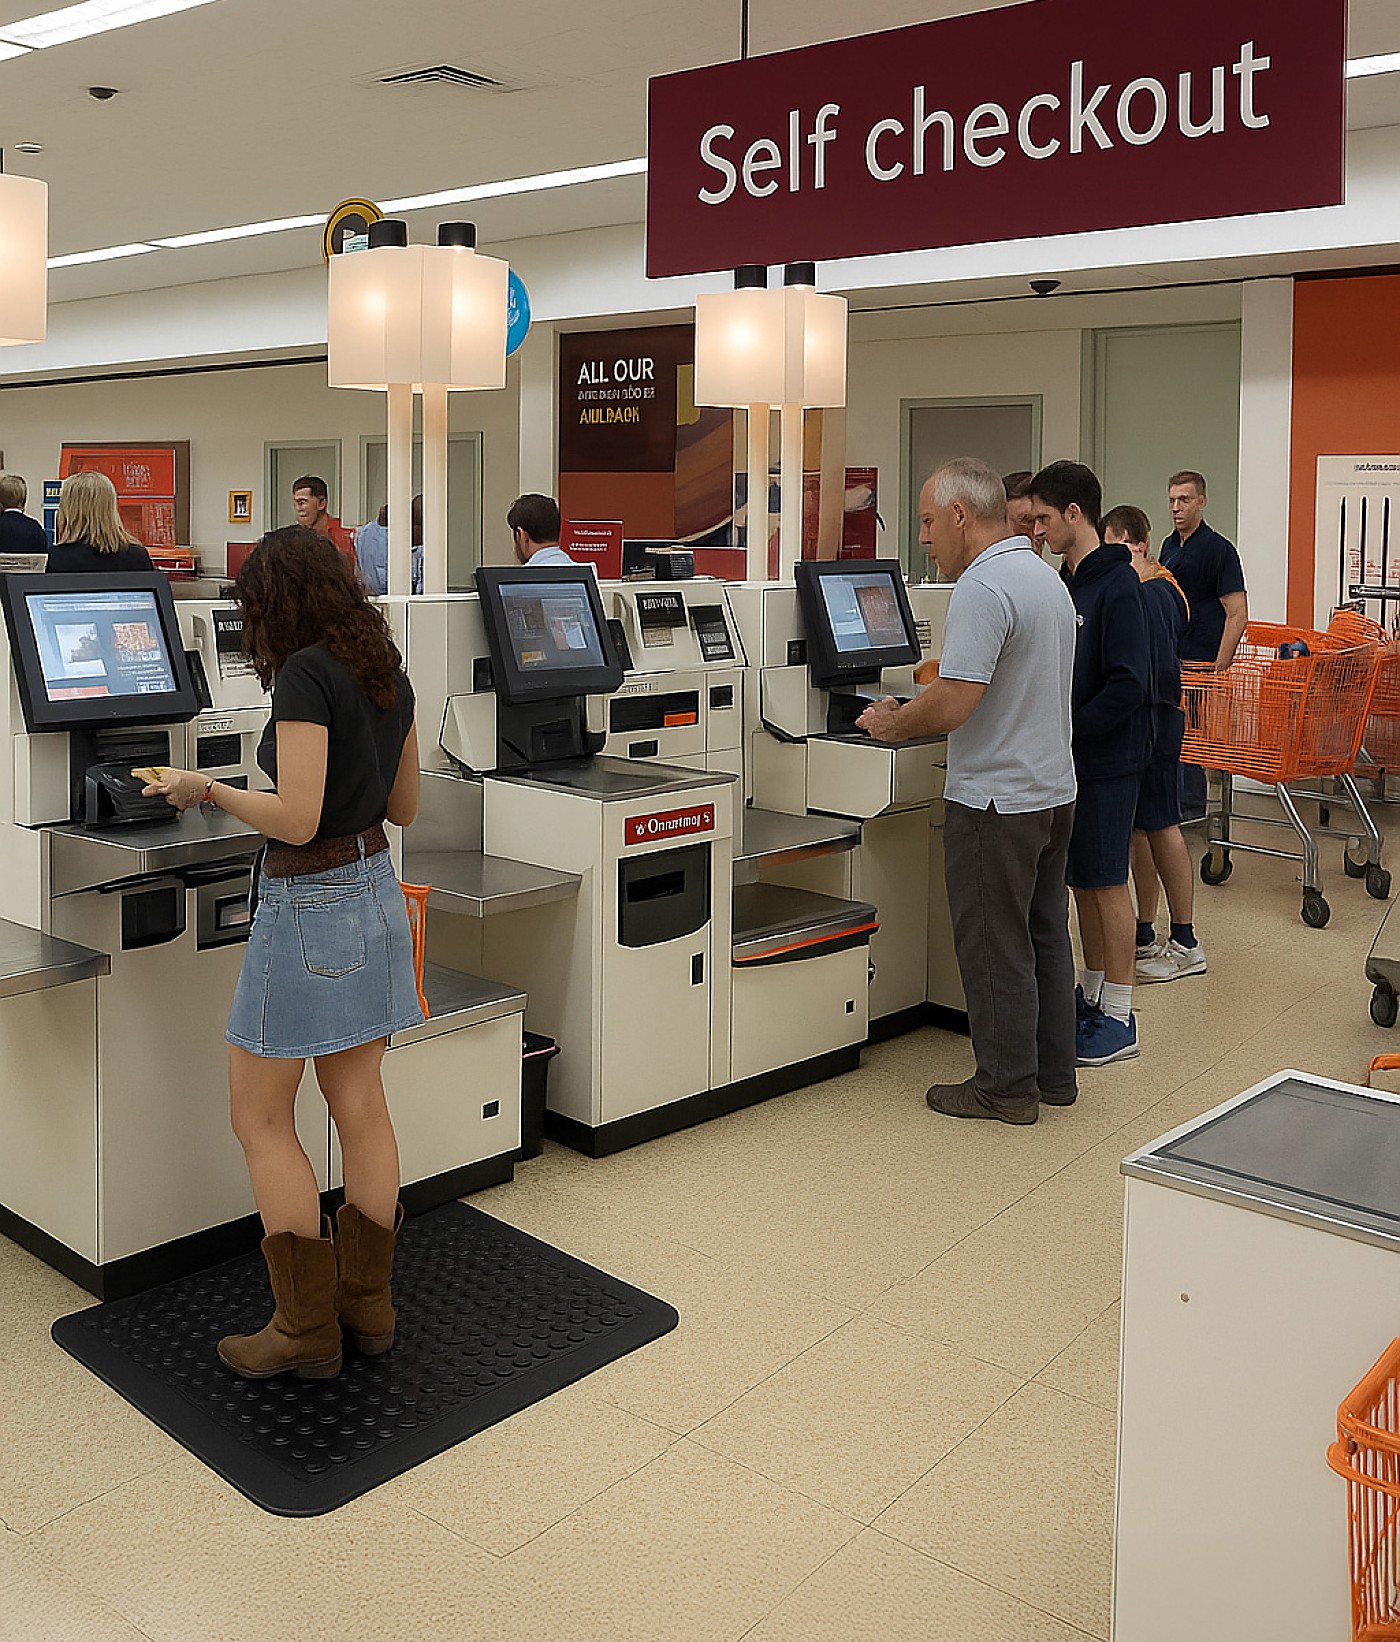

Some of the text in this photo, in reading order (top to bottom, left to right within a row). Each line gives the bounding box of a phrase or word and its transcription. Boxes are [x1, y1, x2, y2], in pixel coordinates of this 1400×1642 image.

[698, 41, 1271, 205] Self checkout
[577, 357, 655, 385] ALL OUR
